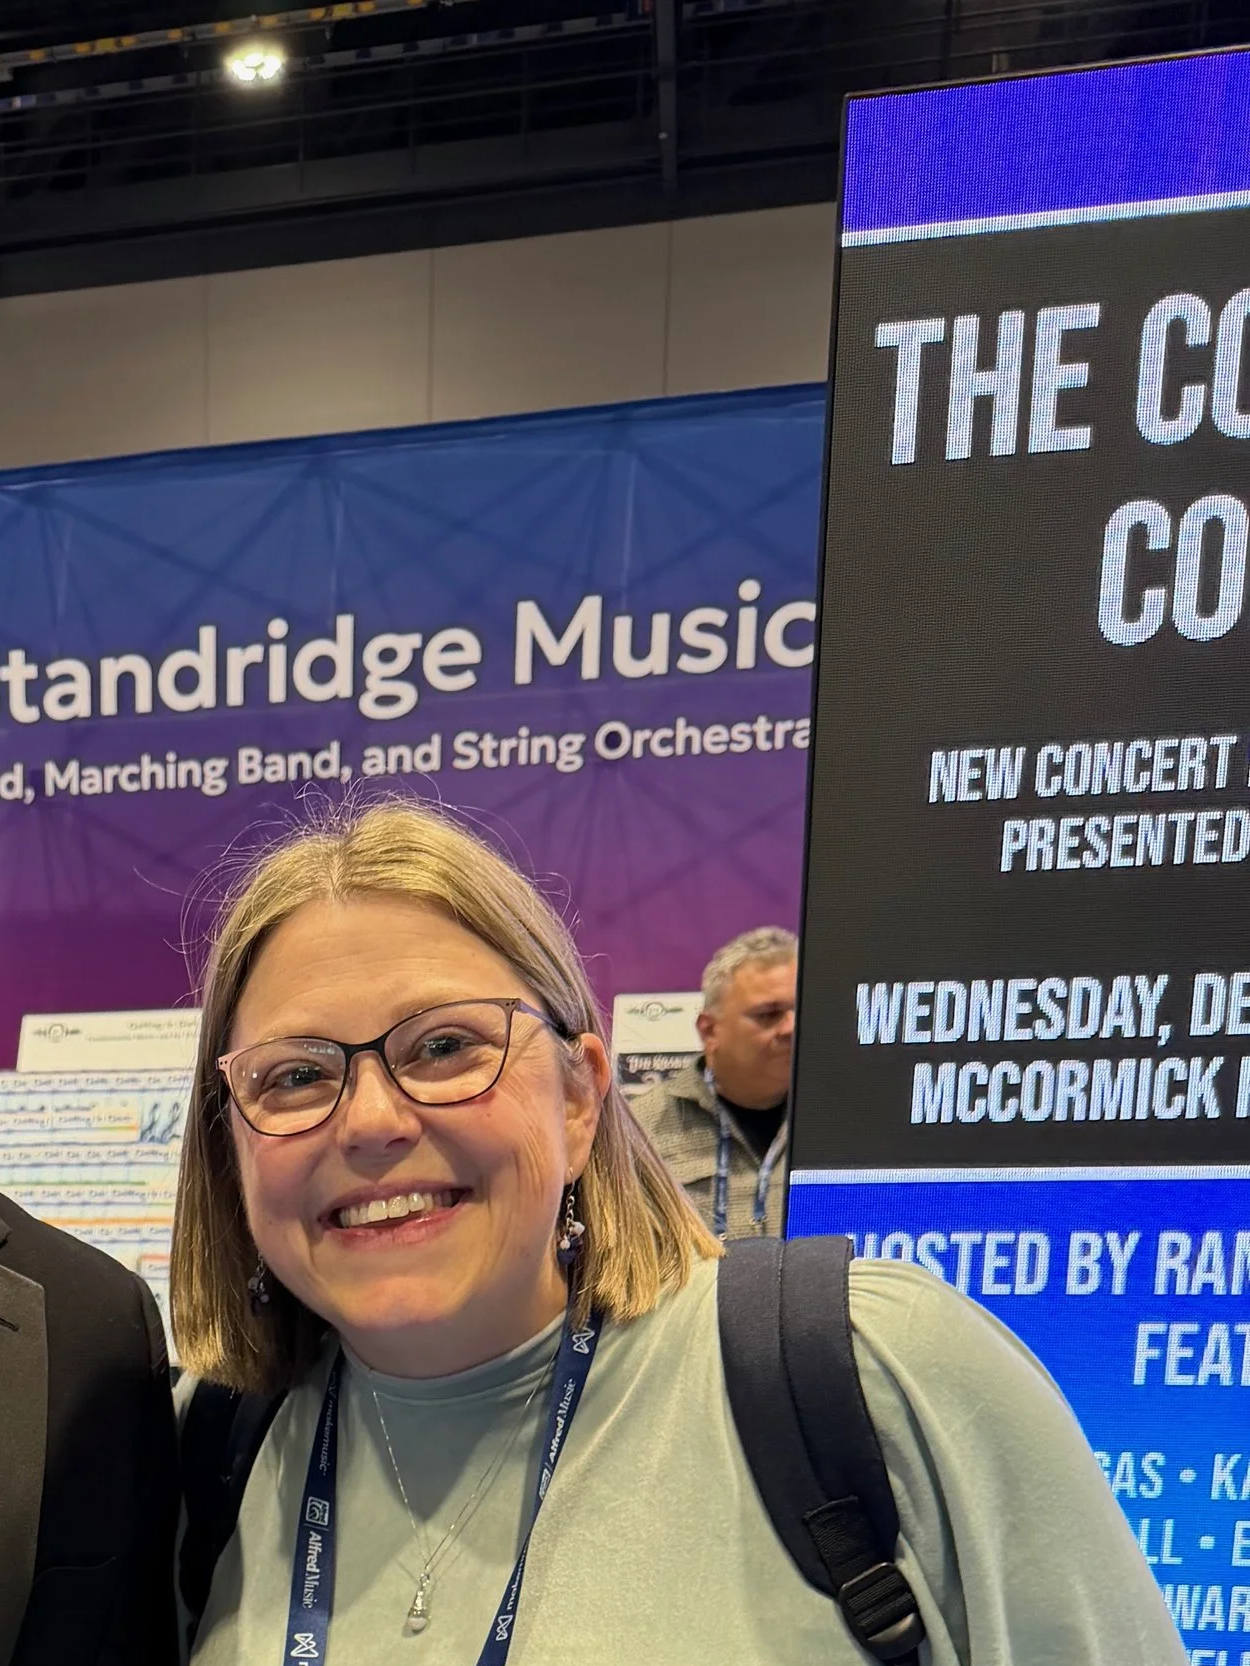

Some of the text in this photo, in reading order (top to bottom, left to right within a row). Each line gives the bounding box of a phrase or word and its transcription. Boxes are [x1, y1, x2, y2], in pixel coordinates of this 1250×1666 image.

[874, 303, 1100, 465] THE
[1098, 495, 1249, 646] CO
[515, 579, 816, 684] Music
[45, 751, 229, 797] Marching
[238, 740, 351, 784] Band,
[363, 733, 442, 777] and
[452, 726, 586, 774] String
[594, 715, 810, 760] Orchestra
[929, 736, 1237, 803] NEW CONCERT
[1001, 810, 1250, 873] PRESENTED
[856, 974, 1171, 1047] WEDNESDAY,
[910, 1057, 1225, 1124] MCCORMICK
[1065, 1231, 1141, 1295] BY
